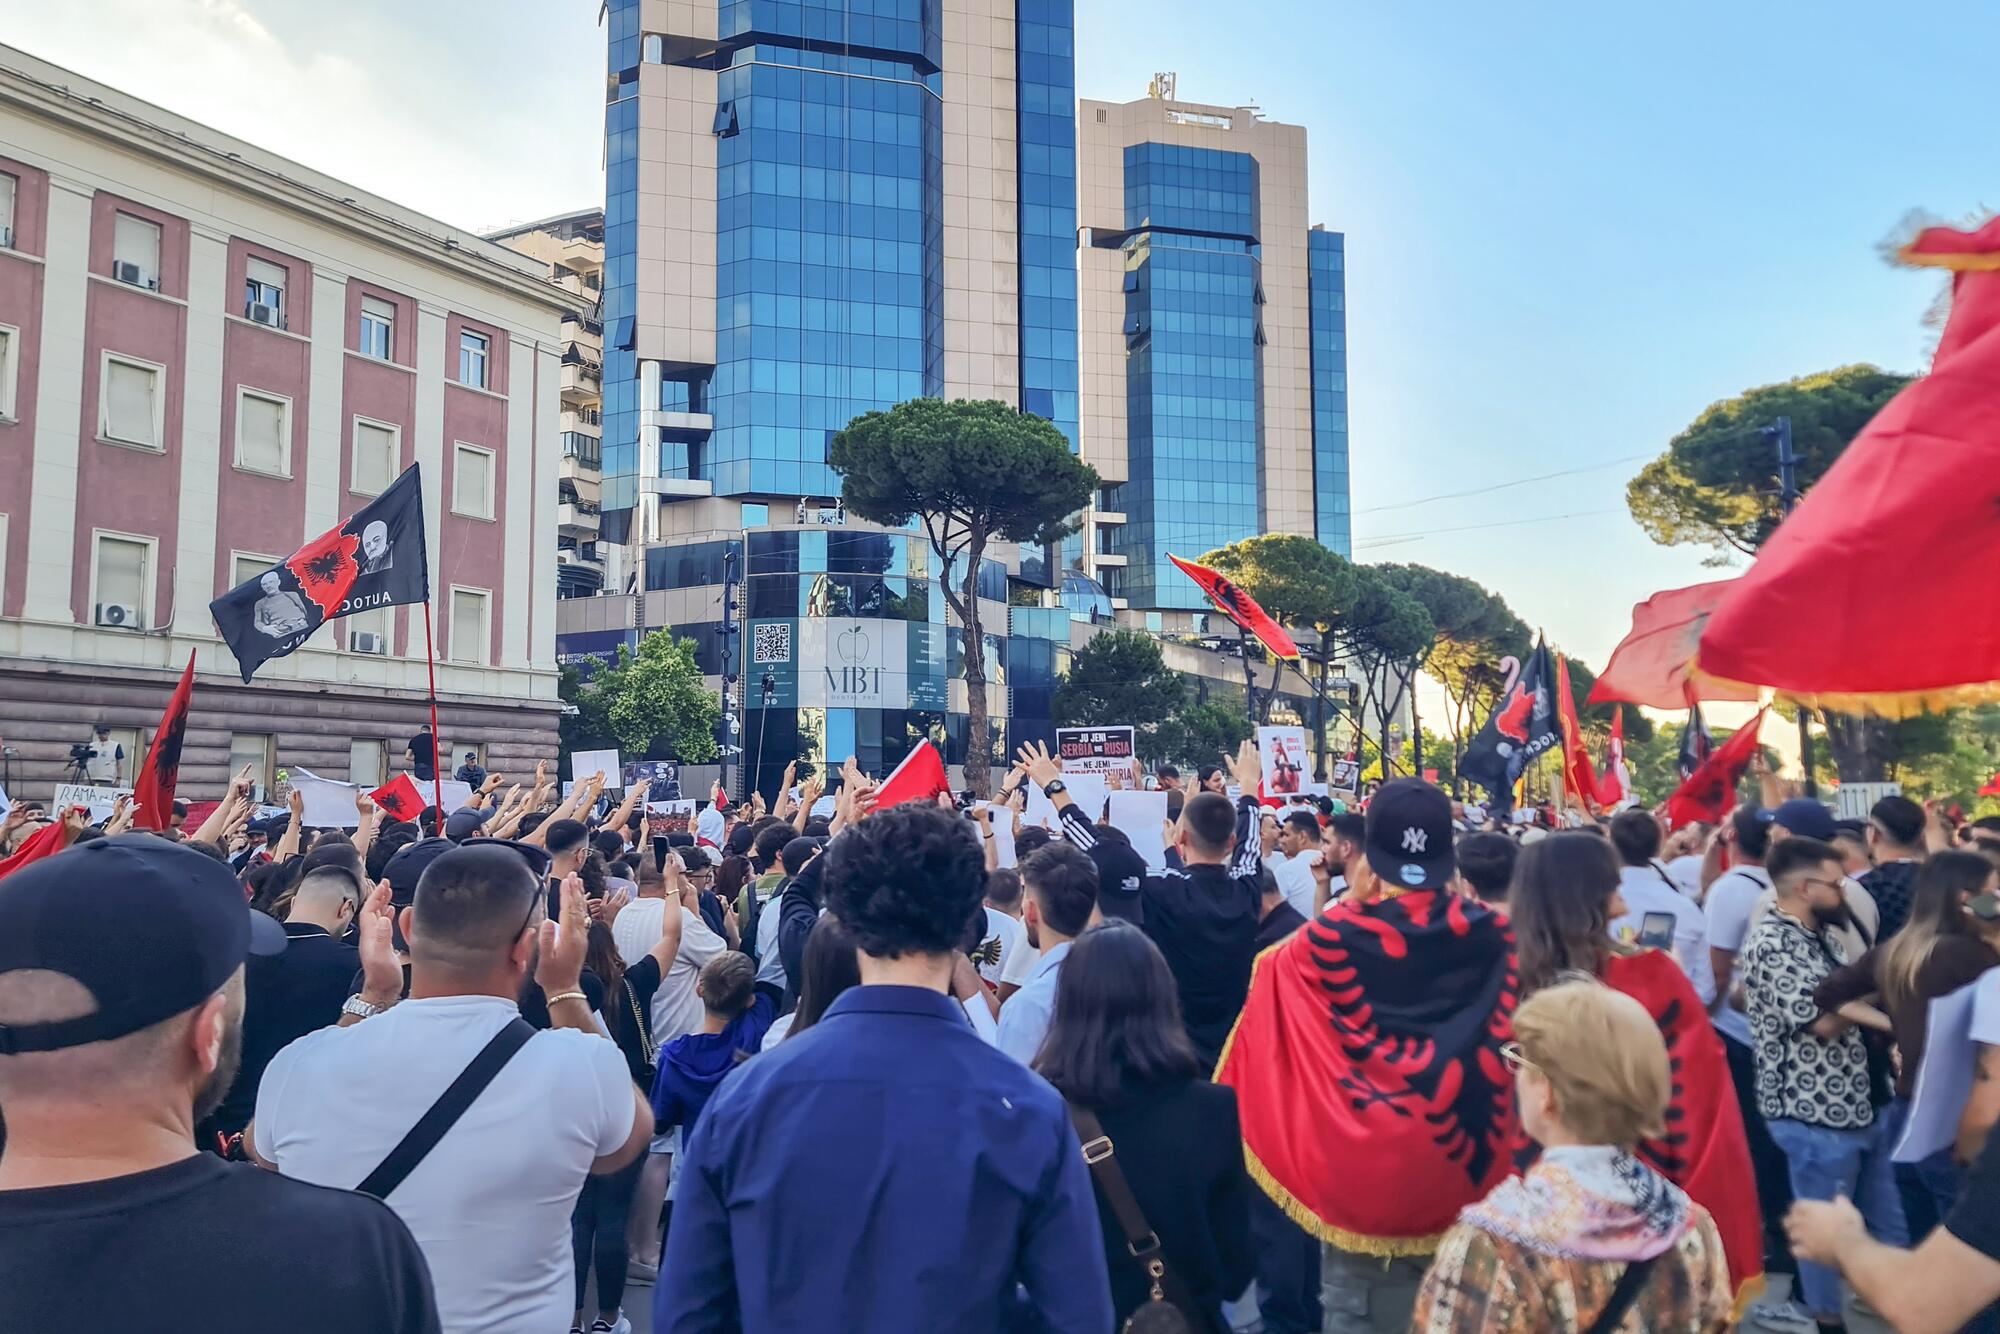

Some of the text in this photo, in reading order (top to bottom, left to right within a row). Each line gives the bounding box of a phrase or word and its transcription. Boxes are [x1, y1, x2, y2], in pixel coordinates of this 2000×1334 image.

[825, 666, 886, 694] MBT
[1079, 732, 1107, 743] JU JENI
[1061, 743, 1094, 757] SERBIA
[1103, 741, 1131, 755] RUSIA
[1083, 760, 1111, 769] NE JEMI
[60, 786, 98, 802] RAMA
[1401, 826, 1428, 853] NY
